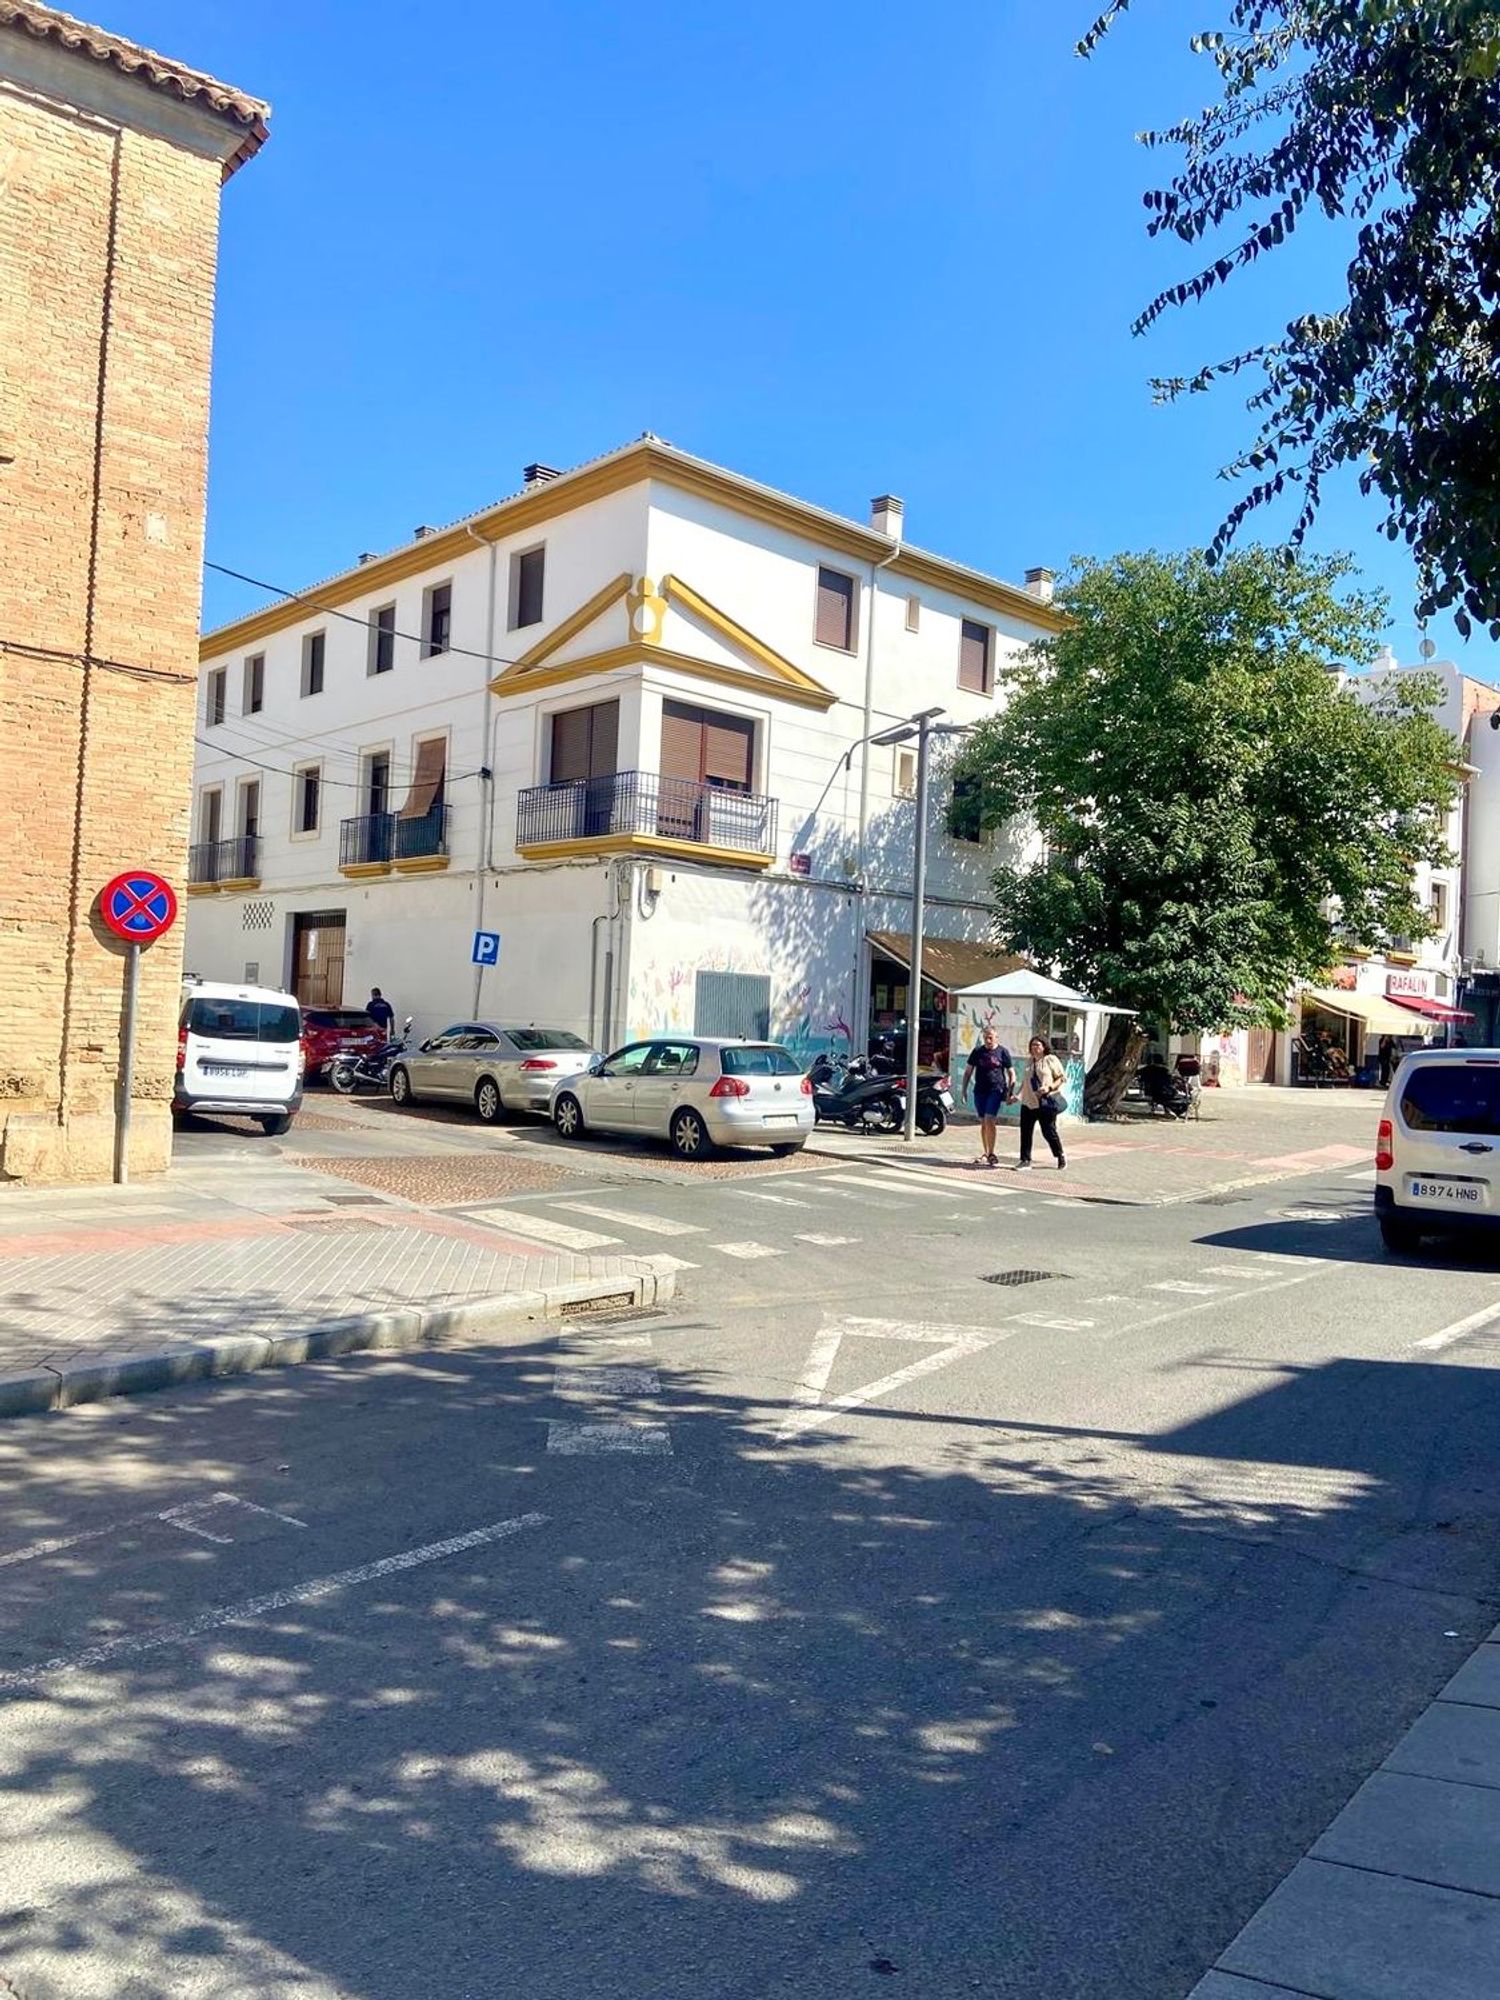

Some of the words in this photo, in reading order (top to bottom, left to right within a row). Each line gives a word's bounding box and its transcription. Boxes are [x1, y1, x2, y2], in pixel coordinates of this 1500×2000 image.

[477, 935, 494, 961] P
[1420, 1184, 1453, 1197] 8974
[1456, 1188, 1479, 1201] HNB
